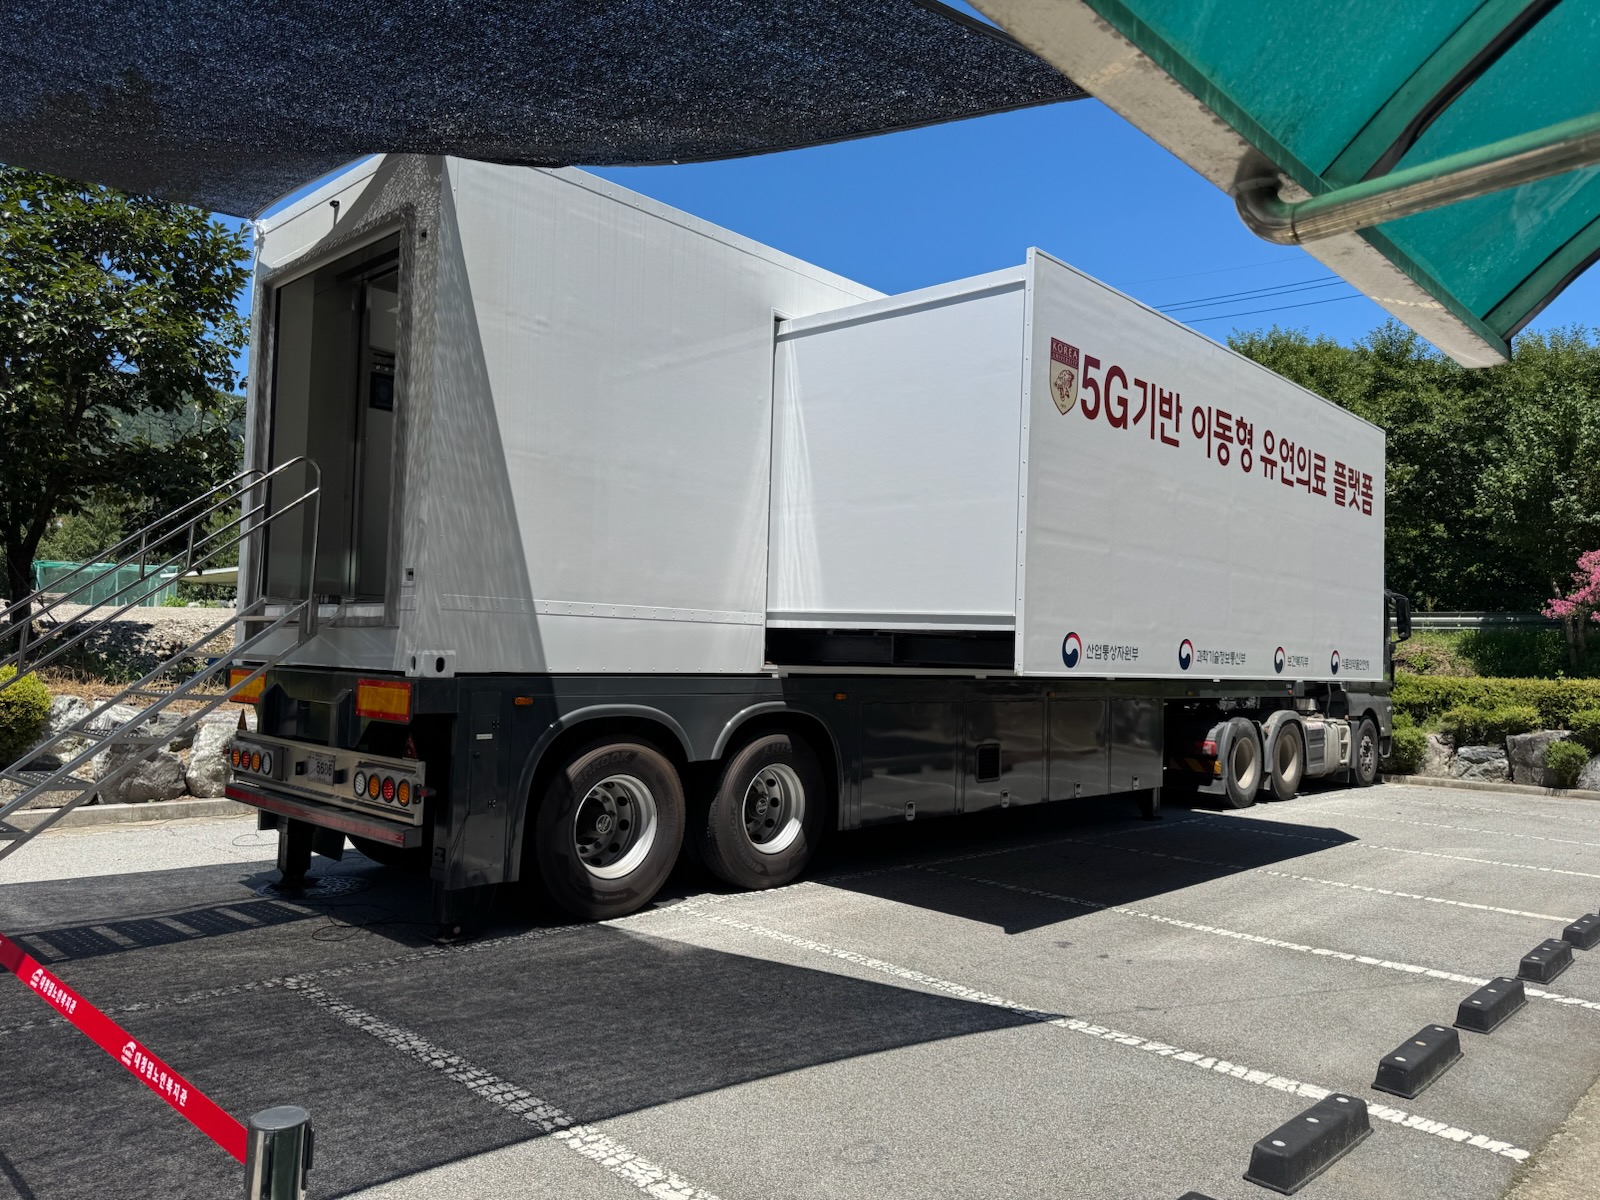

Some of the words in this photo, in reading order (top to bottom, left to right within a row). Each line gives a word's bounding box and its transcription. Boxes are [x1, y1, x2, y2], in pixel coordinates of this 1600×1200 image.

[1052, 342, 1078, 360] KOREA
[1080, 354, 1183, 448] 5G기반
[1191, 405, 1254, 473] 이동형
[1260, 429, 1327, 497] 유연의료
[1333, 460, 1374, 516] 플랫폼
[1086, 643, 1139, 661] 산업통상자원부
